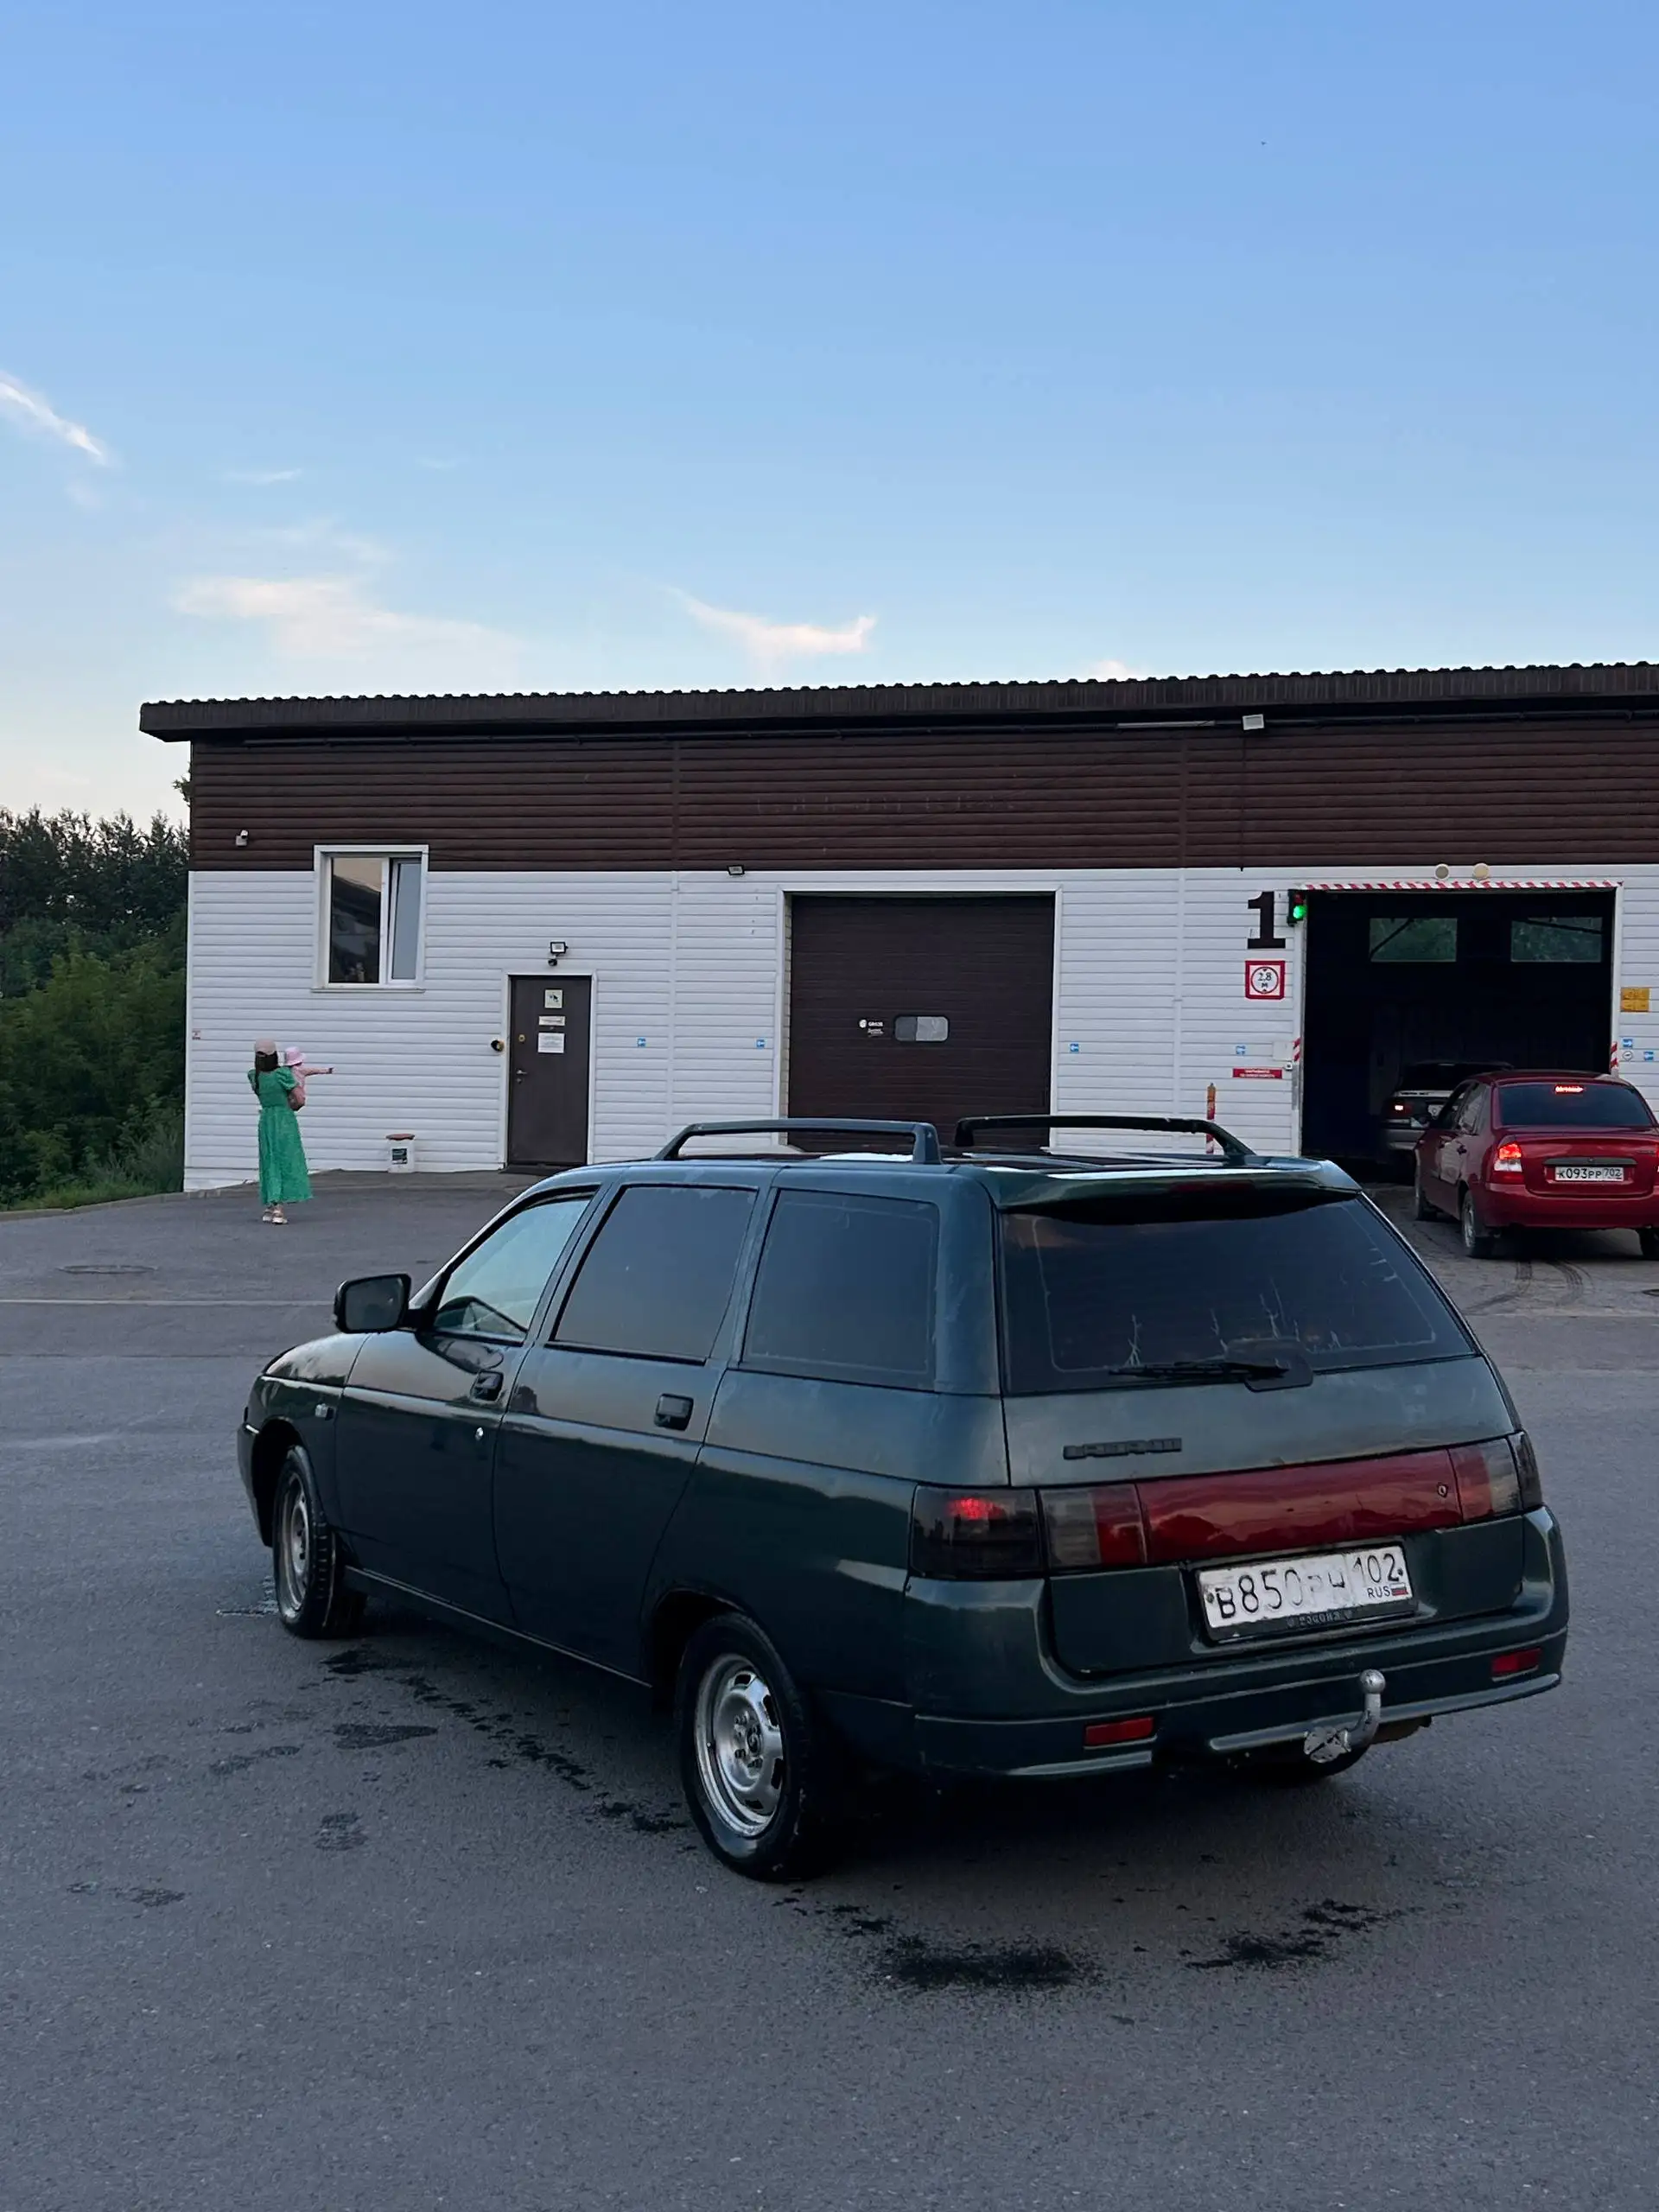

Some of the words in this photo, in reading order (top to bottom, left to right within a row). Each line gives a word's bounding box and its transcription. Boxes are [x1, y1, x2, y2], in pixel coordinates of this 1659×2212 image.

[1247, 891, 1286, 949] 1
[1352, 1553, 1400, 1583] 102
[1366, 1586, 1391, 1599] RUS
